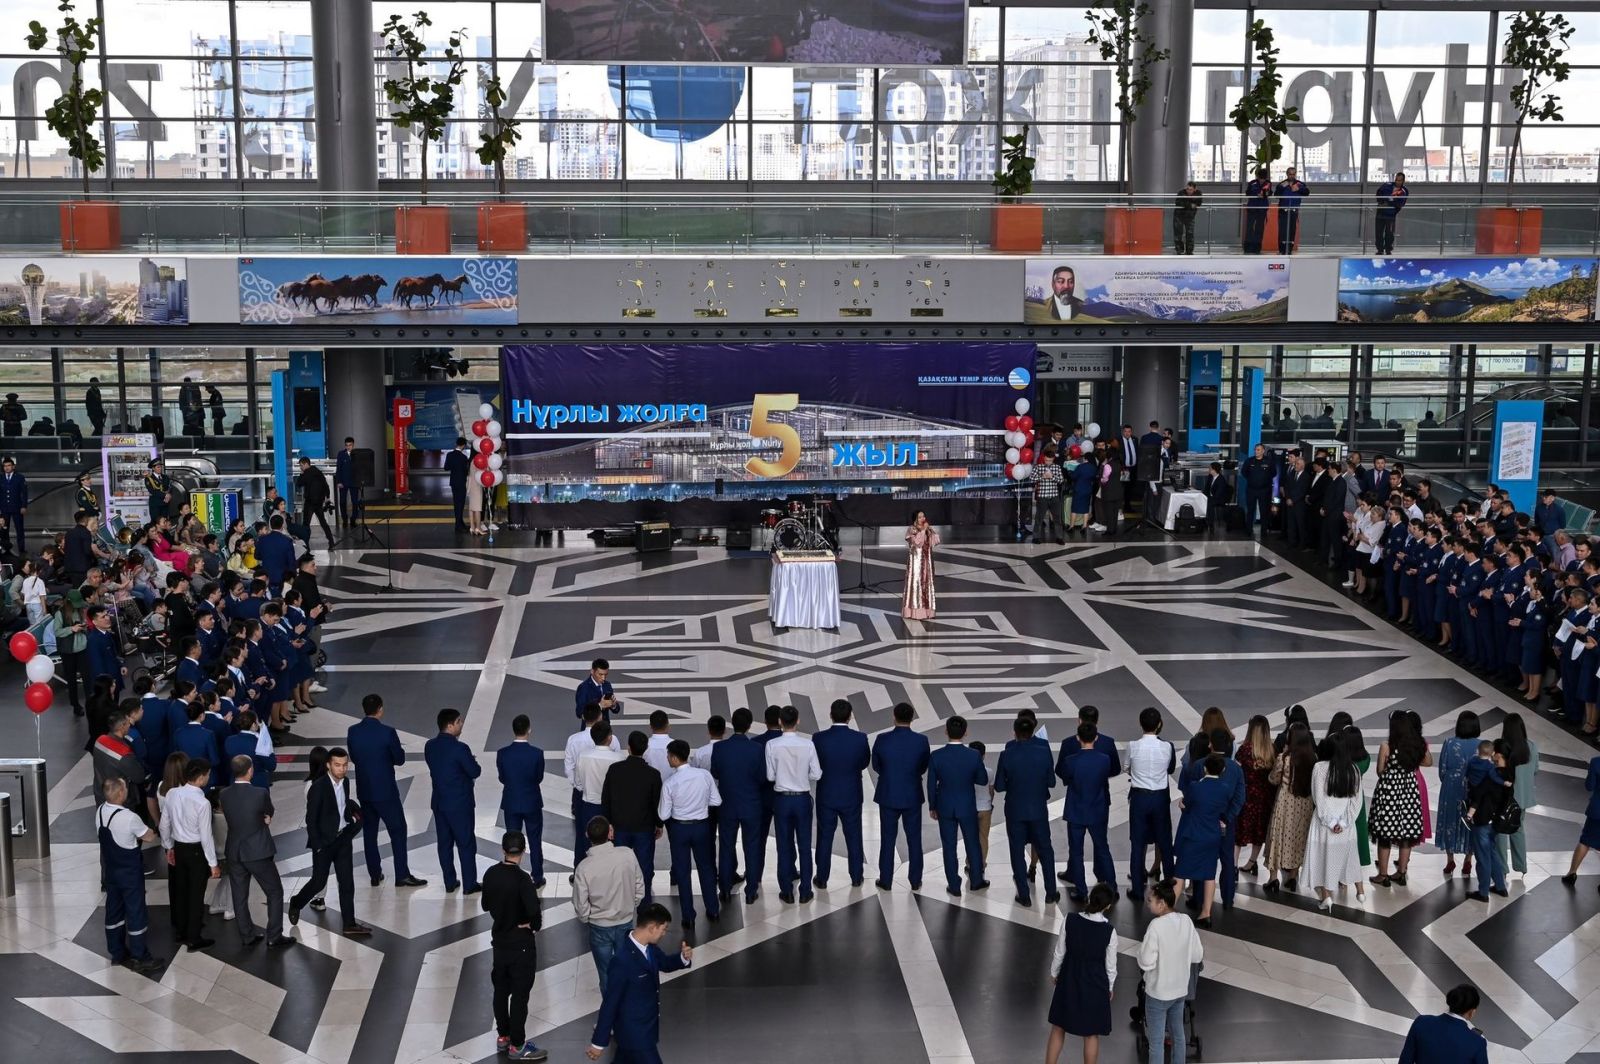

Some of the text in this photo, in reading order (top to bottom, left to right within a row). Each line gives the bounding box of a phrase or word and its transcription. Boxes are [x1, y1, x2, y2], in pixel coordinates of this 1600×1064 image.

[511, 399, 707, 429] Нұрлы жолға
[744, 393, 801, 478] 5
